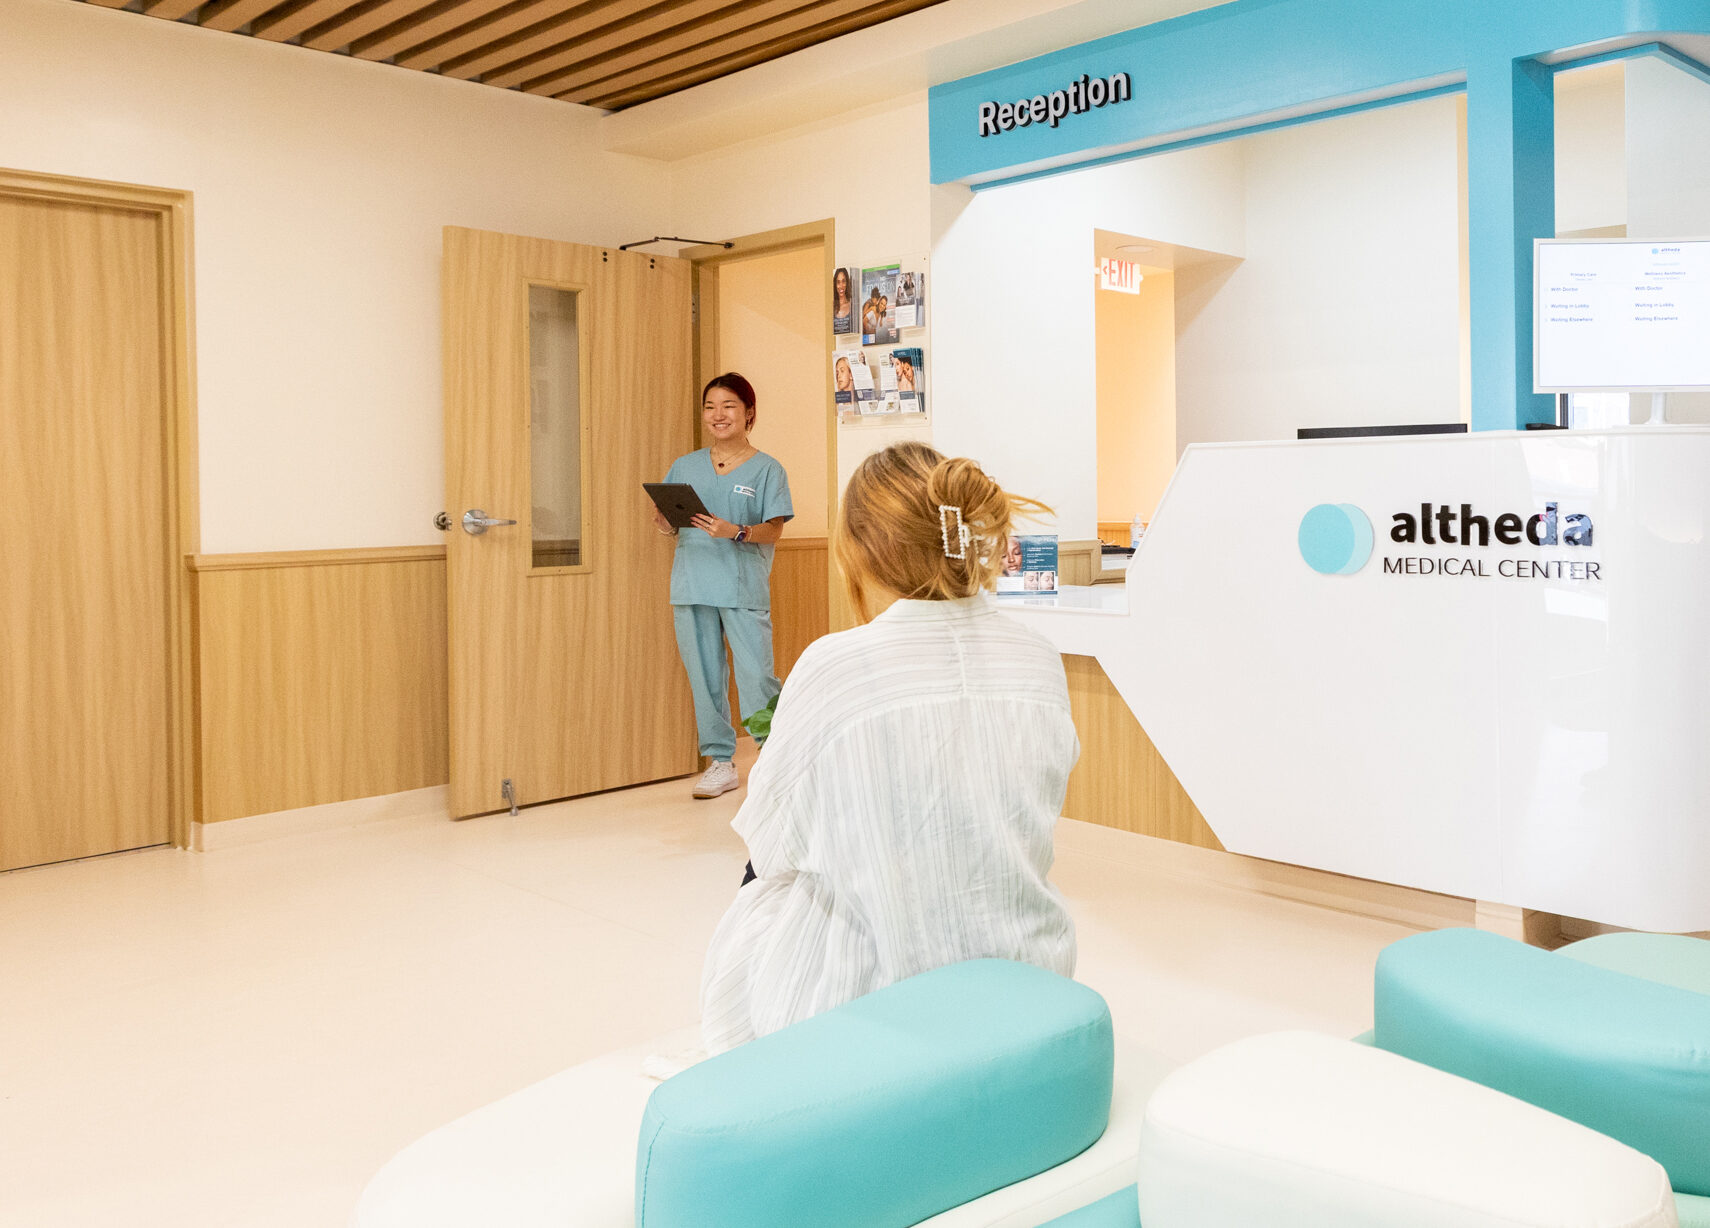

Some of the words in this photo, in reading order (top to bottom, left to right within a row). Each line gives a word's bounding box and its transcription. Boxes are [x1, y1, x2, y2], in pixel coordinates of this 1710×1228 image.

[979, 72, 1132, 138] Reception
[1108, 258, 1136, 289] EXIT
[1390, 501, 1594, 547] altheda
[1383, 557, 1491, 577] MEDICAL
[1498, 559, 1602, 580] CENTER
